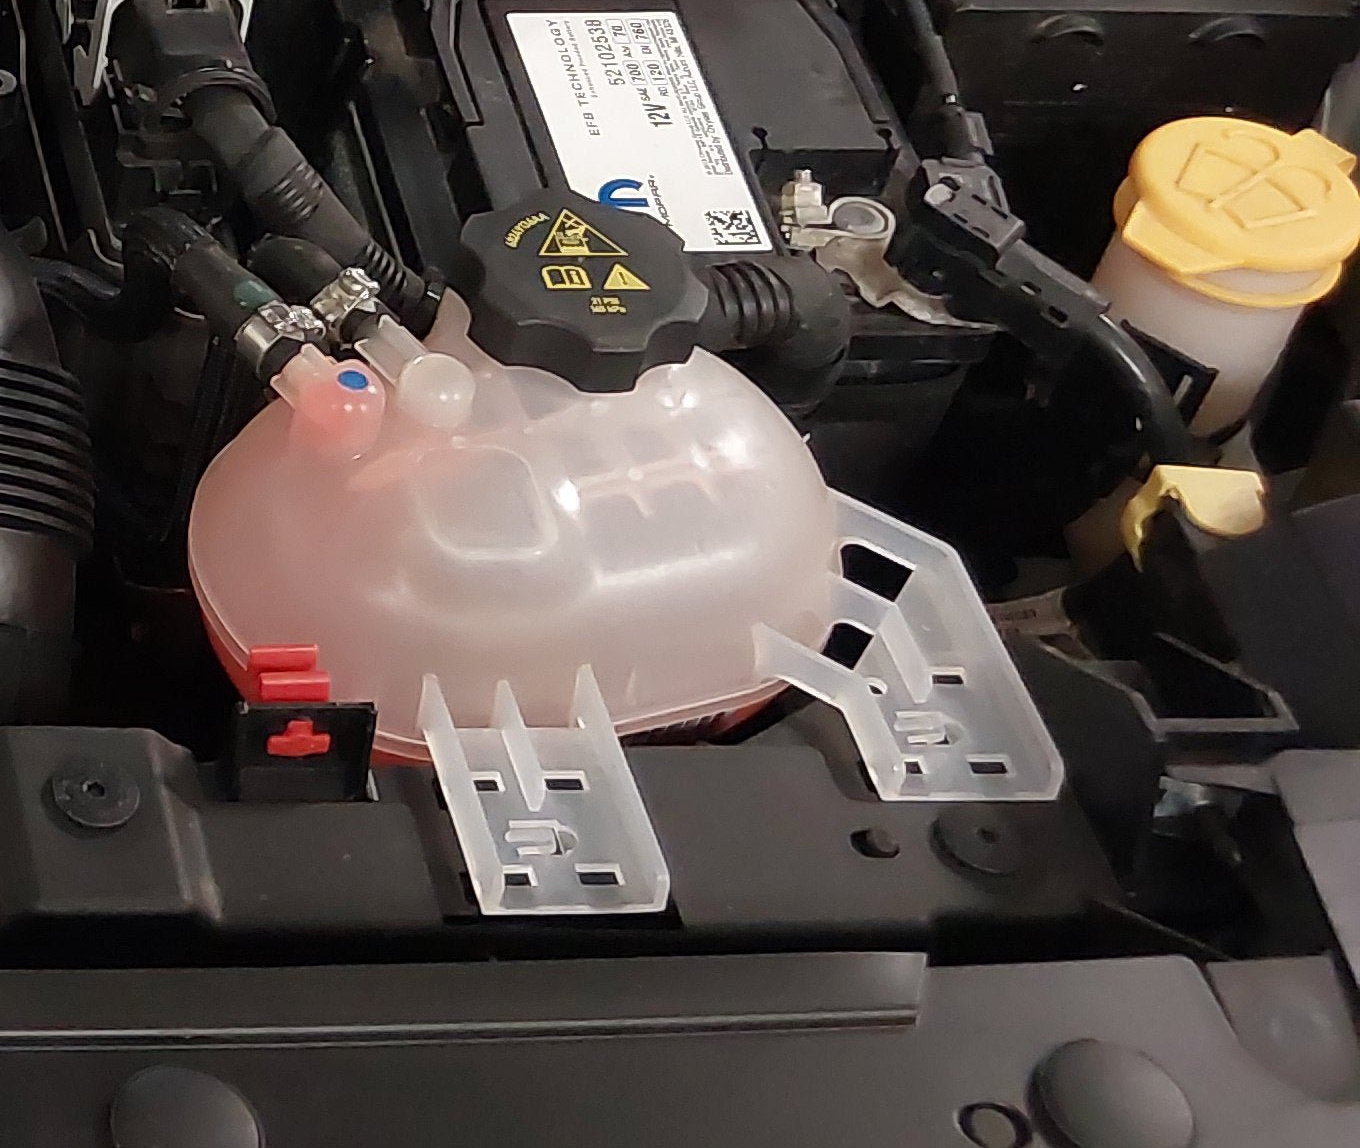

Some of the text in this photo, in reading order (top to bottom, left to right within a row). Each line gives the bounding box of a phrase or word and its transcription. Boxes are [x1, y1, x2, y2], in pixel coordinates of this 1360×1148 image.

[613, 26, 627, 36] 70
[584, 20, 625, 85] 52102538
[546, 20, 600, 135] EFB TECHNOLOGY
[628, 64, 645, 82] 700
[642, 103, 673, 127] 12V
